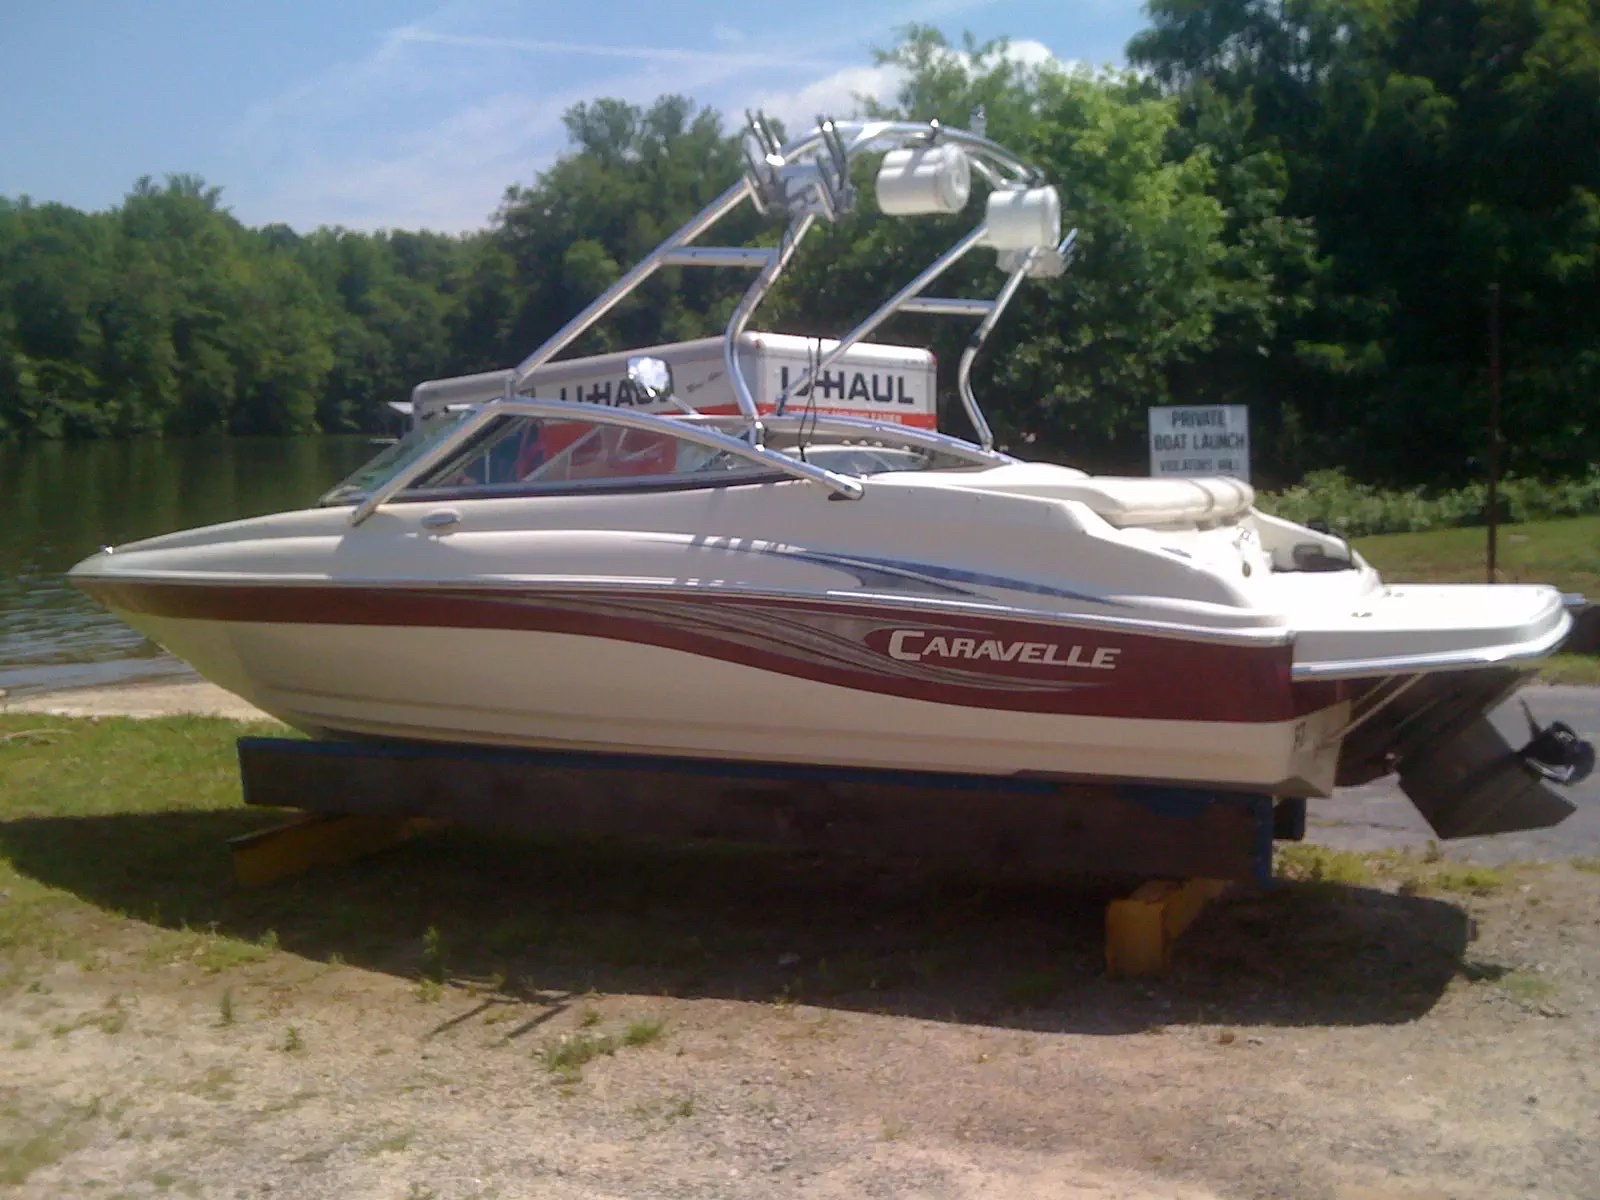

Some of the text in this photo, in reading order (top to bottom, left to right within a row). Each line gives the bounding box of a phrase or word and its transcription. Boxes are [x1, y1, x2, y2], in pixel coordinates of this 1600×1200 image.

[1171, 409, 1224, 427] PRIVATE
[1154, 431, 1244, 451] BOAT LAUNCH
[888, 629, 1121, 669] CARAVELLE
